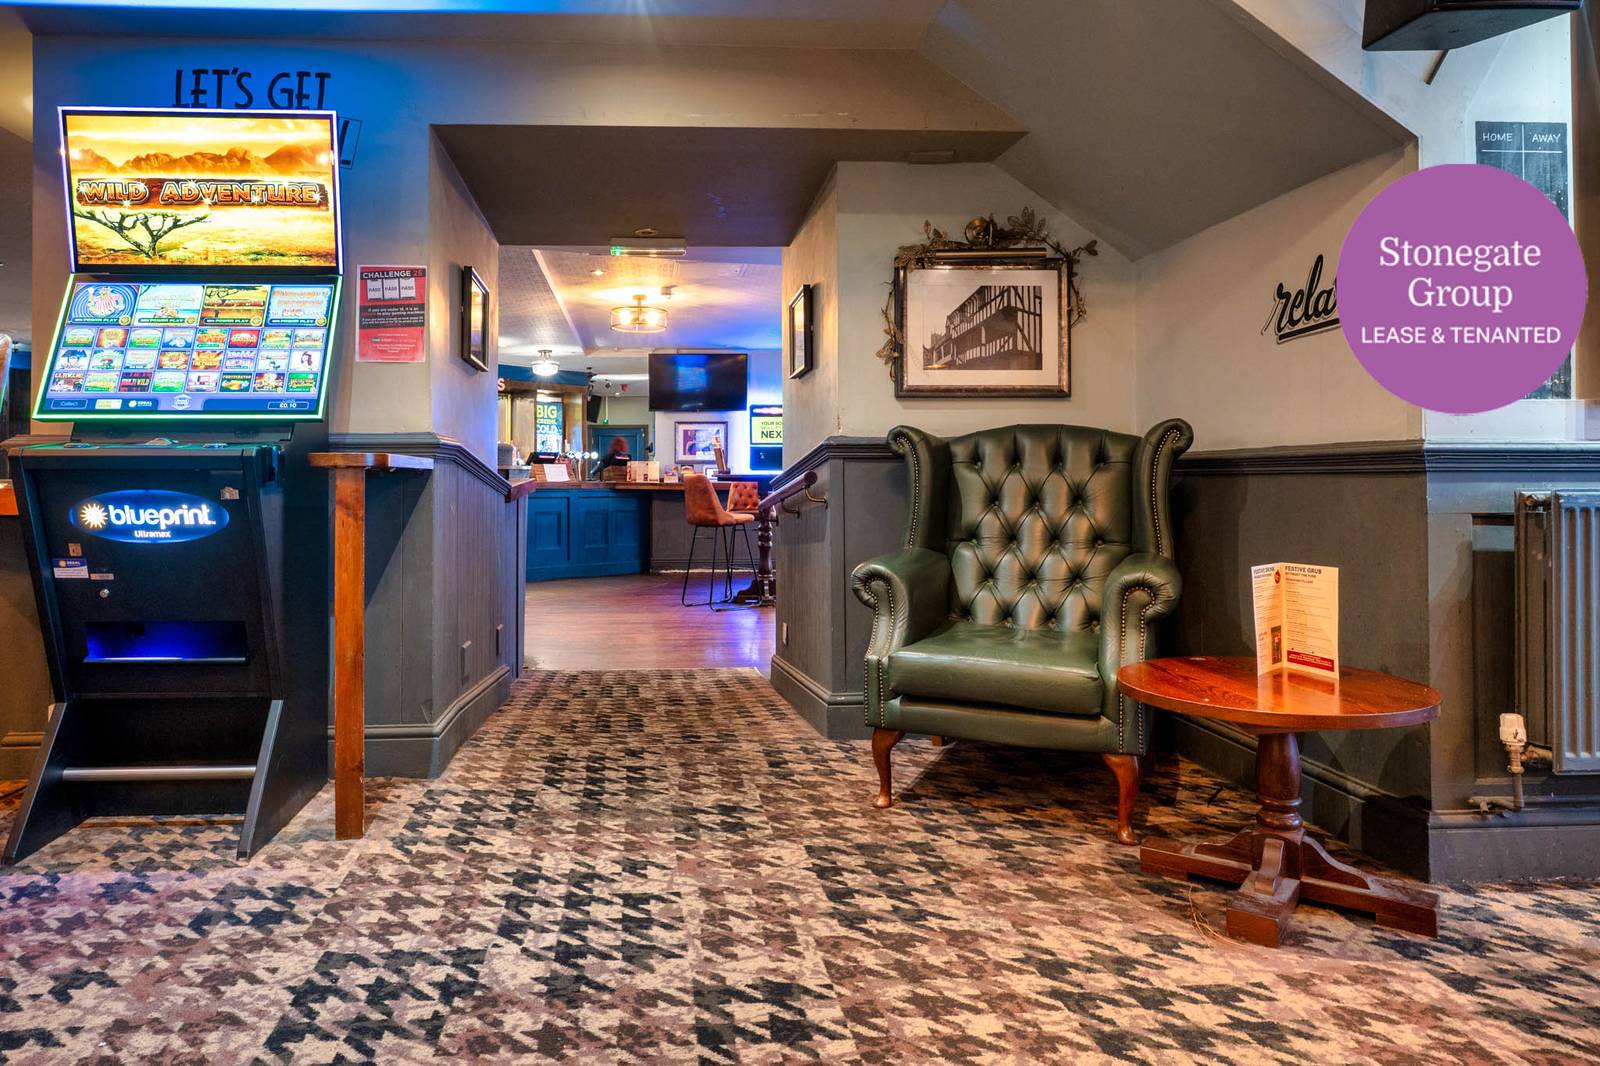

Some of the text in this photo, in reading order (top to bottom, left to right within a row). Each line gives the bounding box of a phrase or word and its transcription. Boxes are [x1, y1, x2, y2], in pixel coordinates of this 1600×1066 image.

[172, 67, 332, 110] LET'S GET
[1482, 132, 1561, 143] HOME AWAY
[80, 180, 321, 206] WILD ADVENTURE
[362, 270, 412, 279] CHALLENGE
[1263, 253, 1338, 333] rela
[536, 404, 557, 419] BIG
[108, 504, 212, 530] blueprint
[134, 530, 172, 538] Ultramax
